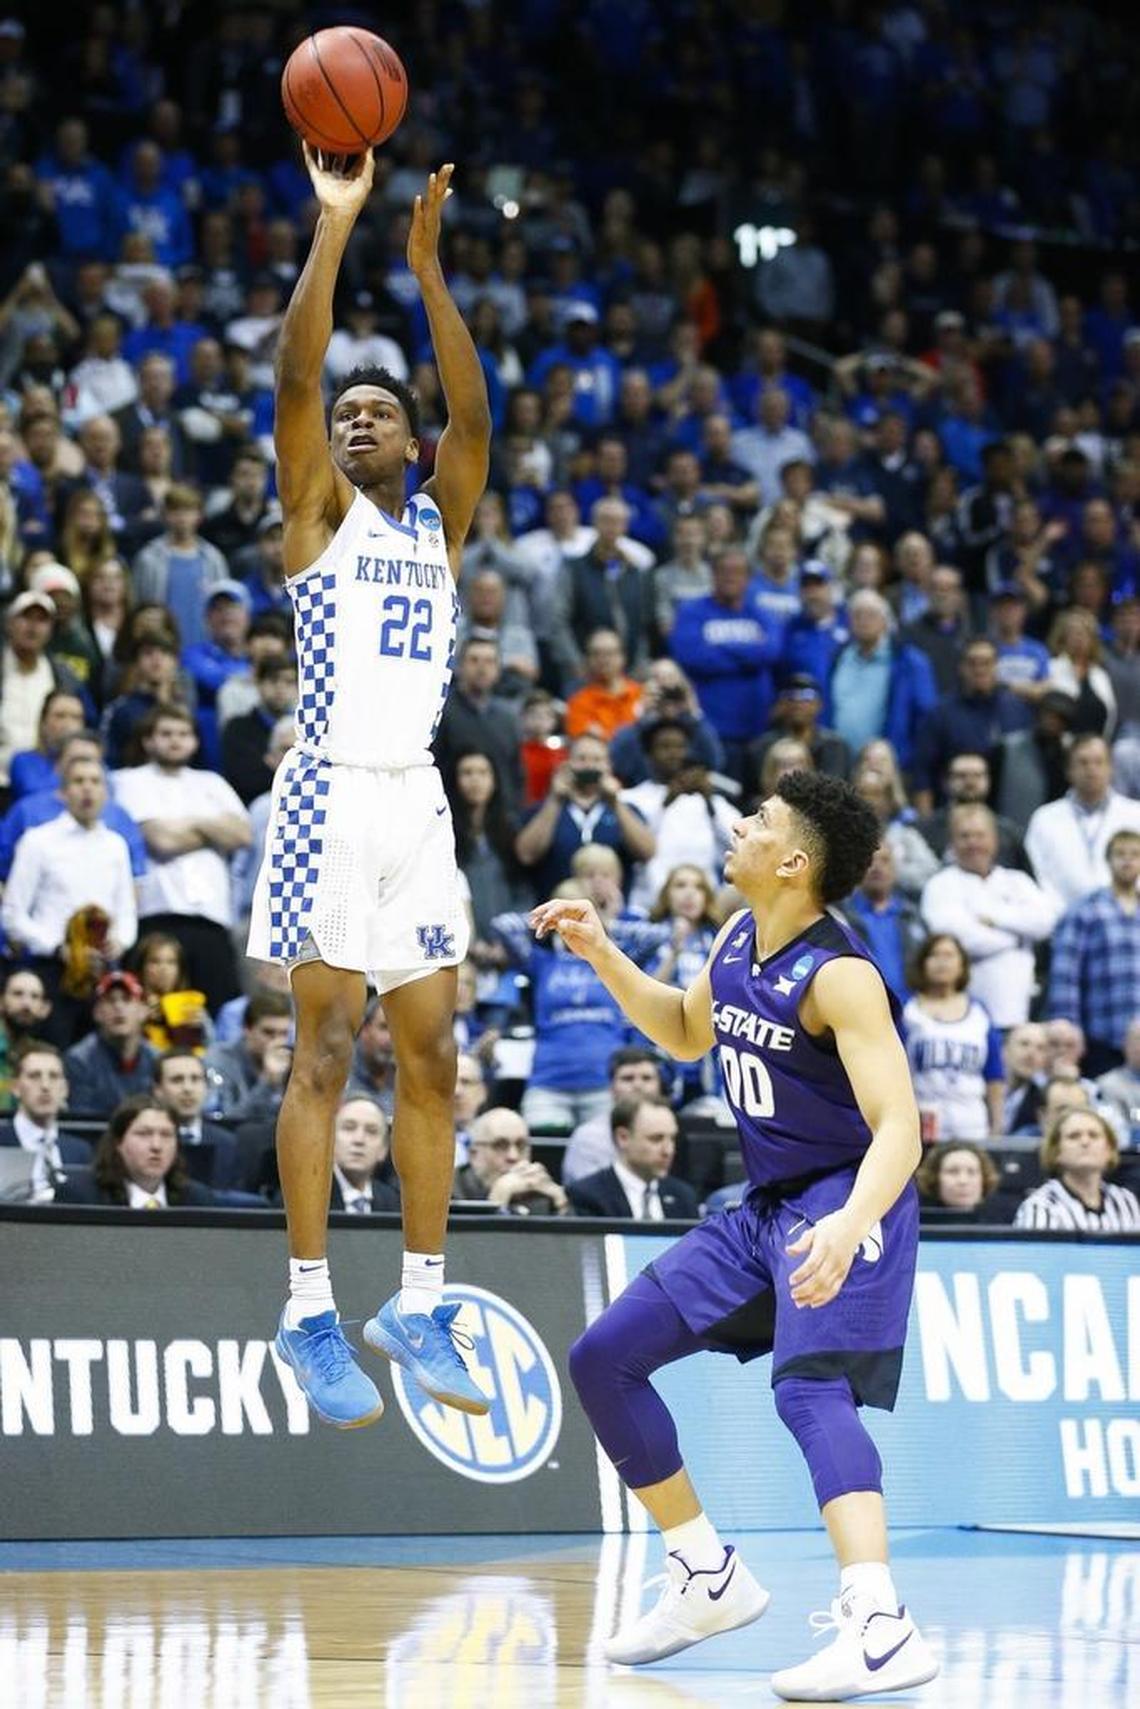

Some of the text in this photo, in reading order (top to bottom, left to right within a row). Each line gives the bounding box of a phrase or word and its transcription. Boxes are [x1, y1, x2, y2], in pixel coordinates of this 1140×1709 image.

[355, 555, 447, 592] KENTUCKY
[379, 595, 433, 661] 22
[416, 924, 456, 960] UK
[720, 1044, 775, 1118] 00
[915, 1271, 1140, 1402] NCA
[0, 1338, 310, 1435] NTUCKY
[1060, 1418, 1140, 1498] HO
